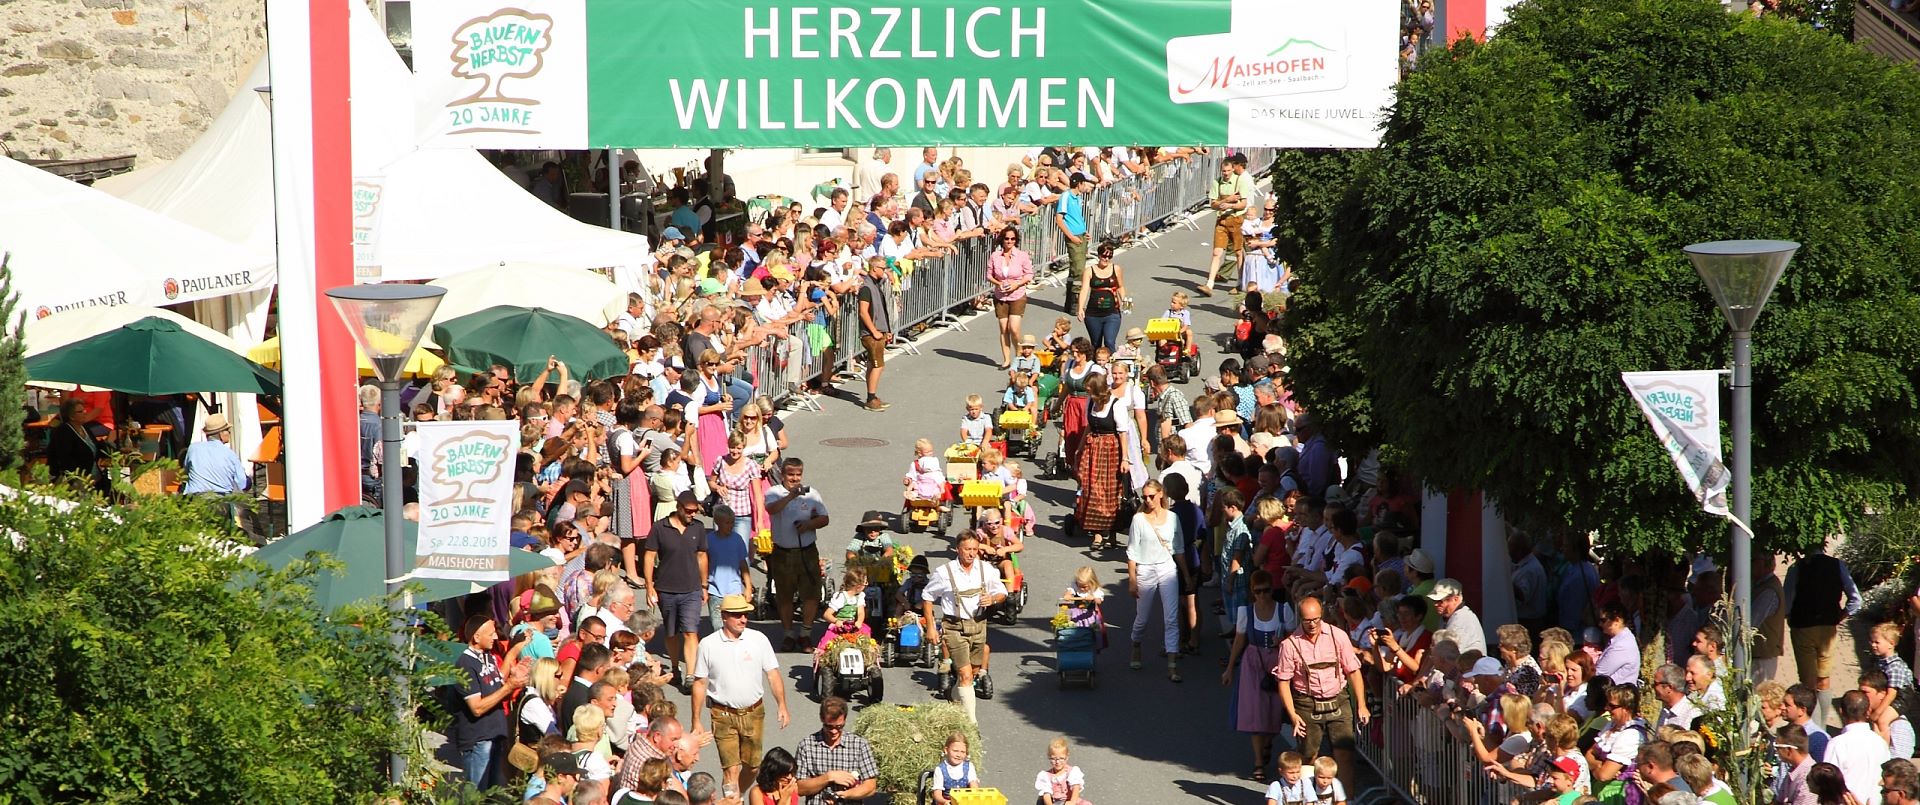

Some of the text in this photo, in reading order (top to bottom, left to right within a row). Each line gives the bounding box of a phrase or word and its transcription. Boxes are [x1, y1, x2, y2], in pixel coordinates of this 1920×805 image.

[470, 23, 541, 51] BAUERN
[744, 6, 1046, 59] HERZLICH
[470, 45, 533, 69] HERBST
[1177, 55, 1325, 95] MAISHOFEN
[1242, 79, 1255, 87] Zell
[1288, 74, 1319, 83] Saalbach
[668, 77, 1116, 131] WILLKOMMEN
[1251, 108, 1275, 119] DAS
[1279, 108, 1321, 119] KLEINE
[450, 106, 533, 126] 20 JAHRE
[182, 270, 252, 293] PAULANER
[447, 441, 502, 463] BAUERN
[447, 460, 496, 477] HERBST
[430, 508, 449, 521] 20
[447, 535, 498, 548] 22.8.2015
[428, 555, 494, 569] MAISHOFEN
